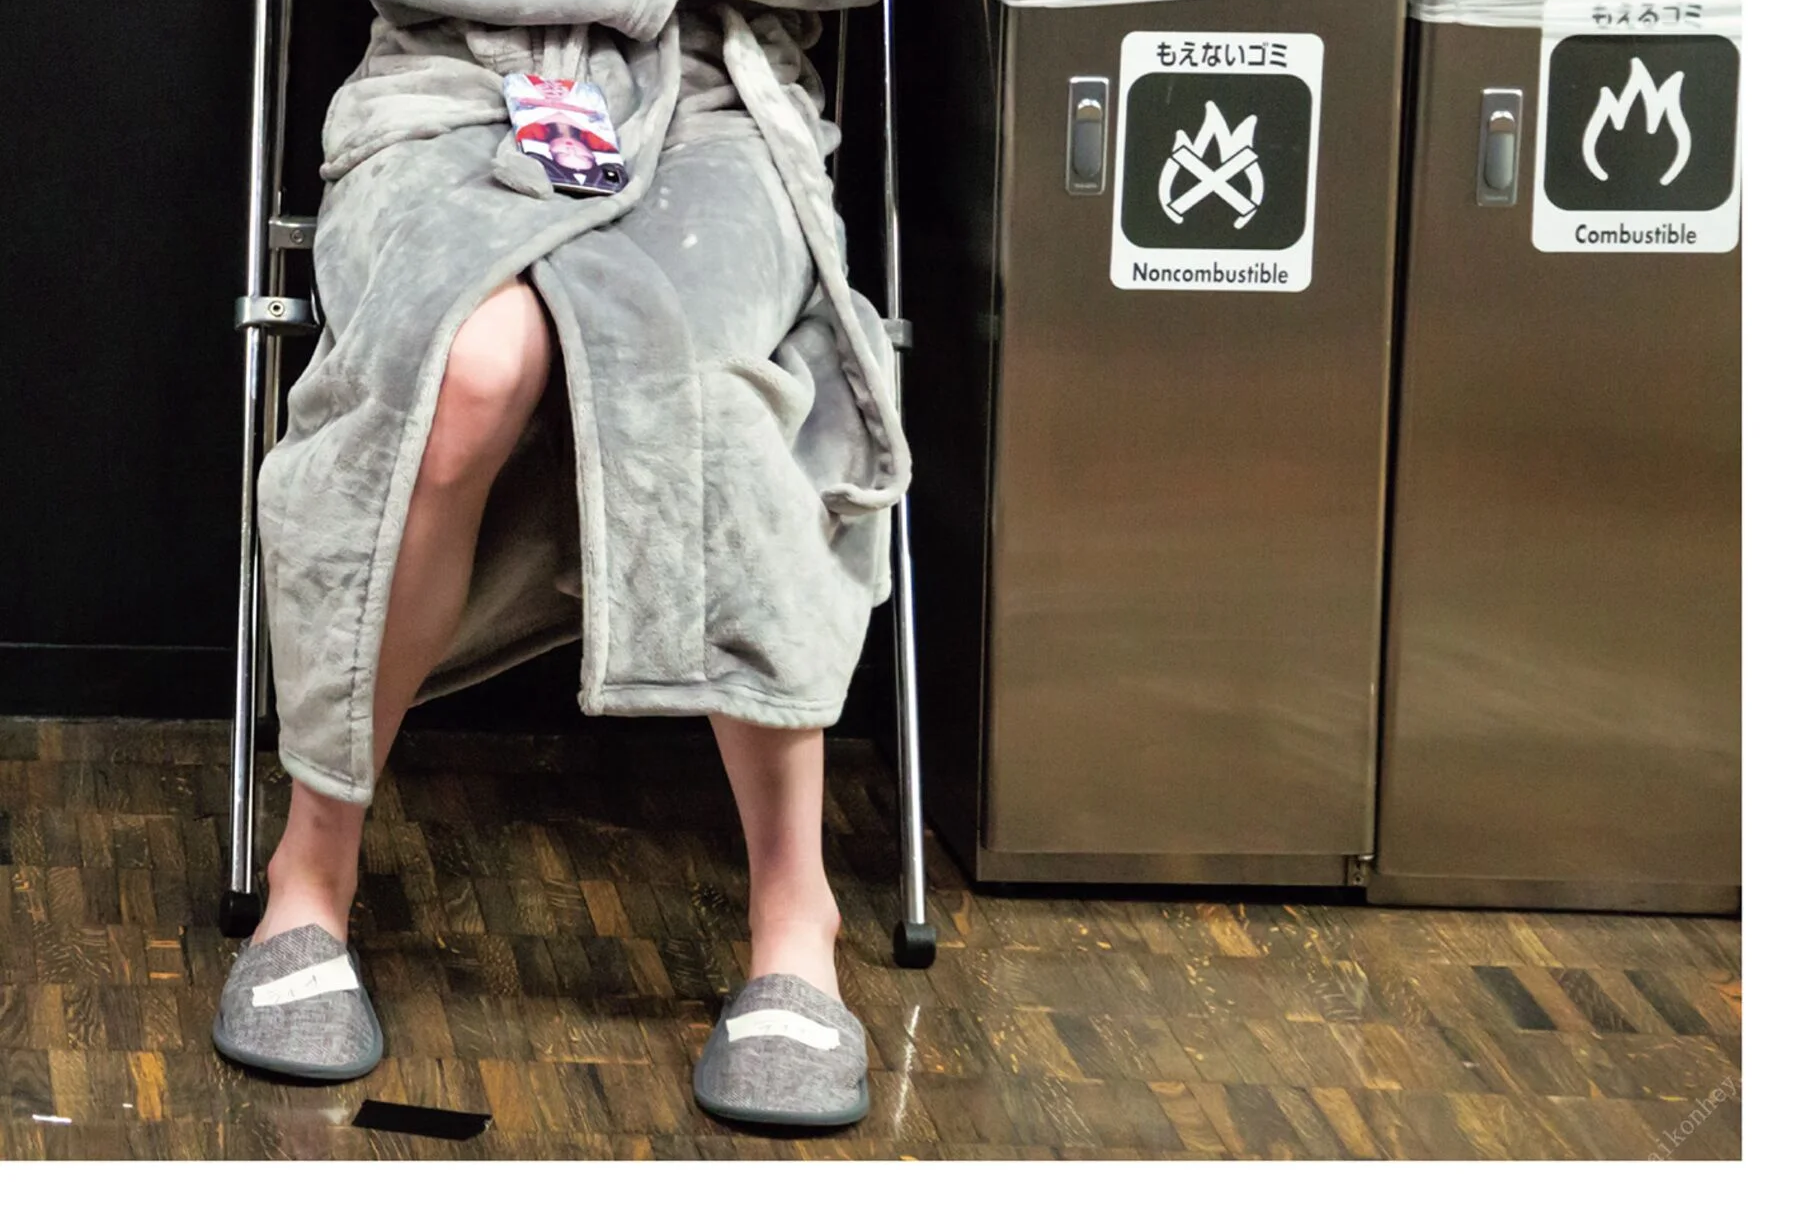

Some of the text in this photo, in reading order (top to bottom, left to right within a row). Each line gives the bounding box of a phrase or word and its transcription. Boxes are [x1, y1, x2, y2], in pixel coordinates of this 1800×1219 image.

[1157, 42, 1288, 68] もえないゴミ
[1575, 223, 1698, 245] Combustible
[1133, 262, 1289, 284] Noncombustible
